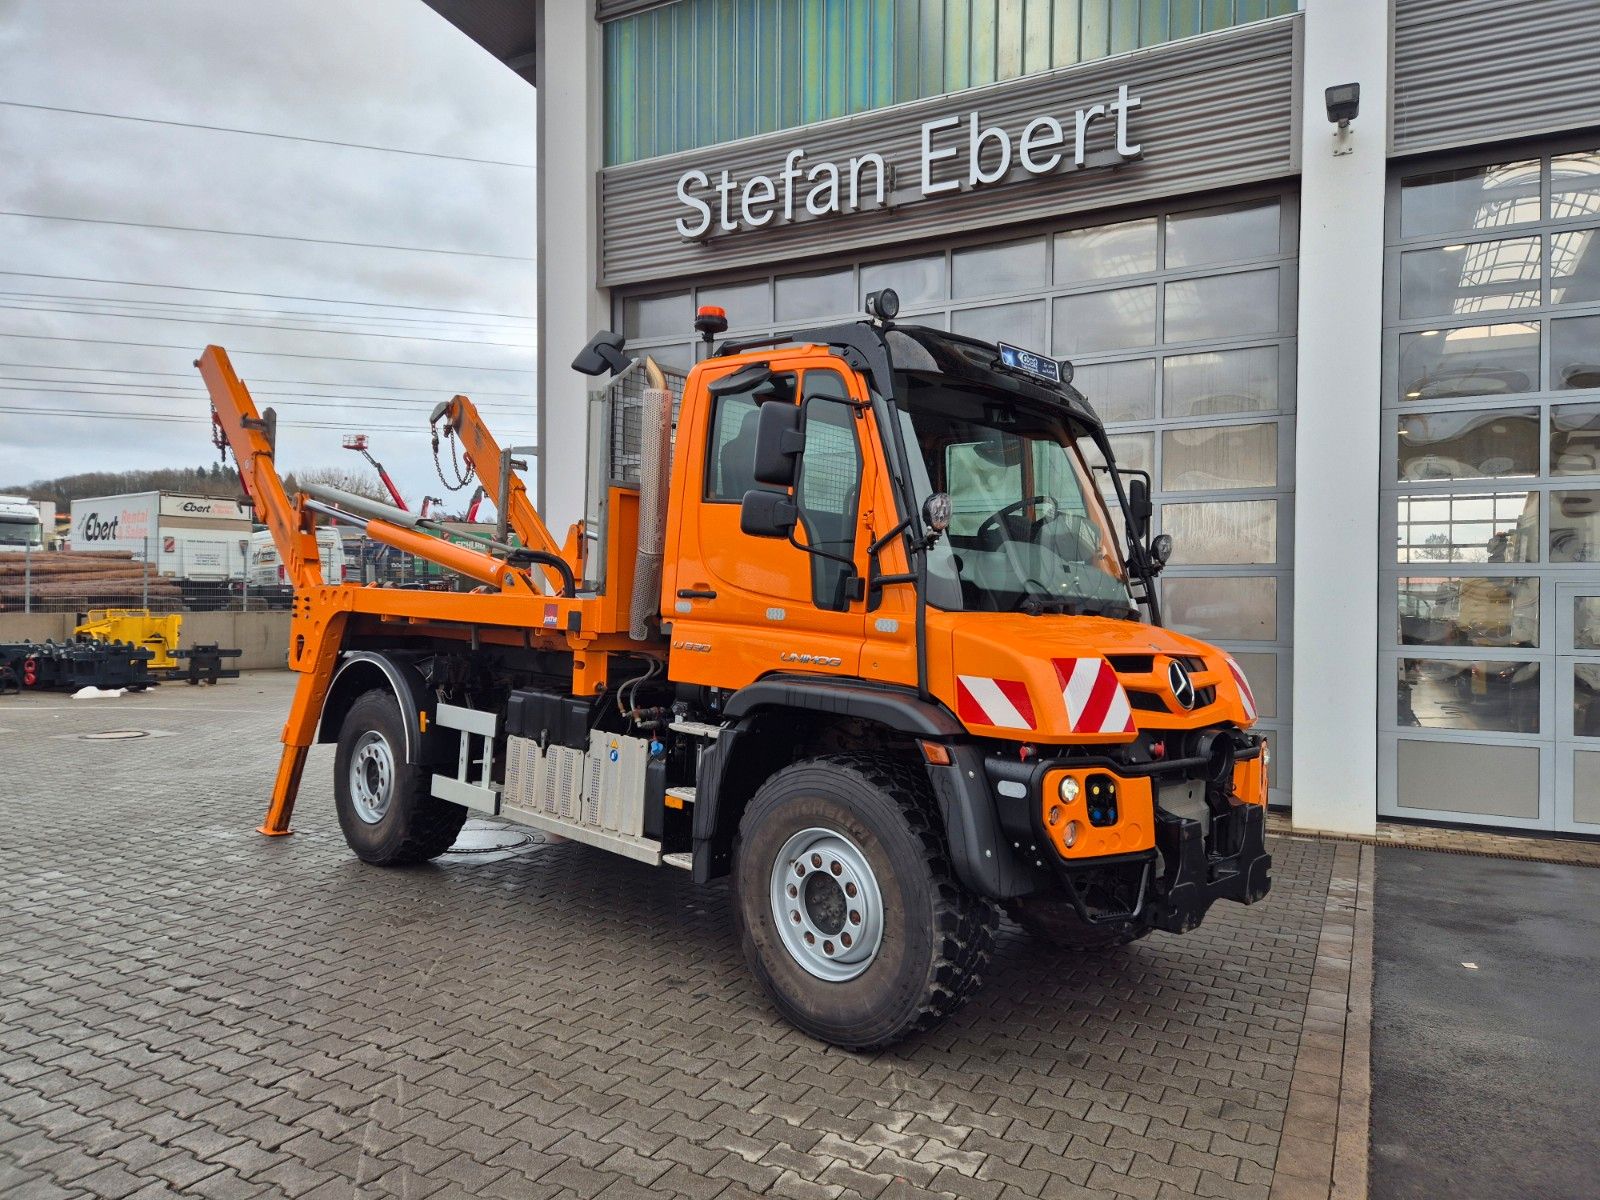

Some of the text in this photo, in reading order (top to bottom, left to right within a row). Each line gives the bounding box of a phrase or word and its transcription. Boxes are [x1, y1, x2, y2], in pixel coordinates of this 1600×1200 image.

[675, 85, 1142, 240] Stefan Ebert
[183, 502, 211, 513] Ebert
[121, 509, 148, 524] Rental
[85, 512, 118, 541] Ebert
[673, 640, 684, 649] U
[780, 652, 842, 667] UNIMOG
